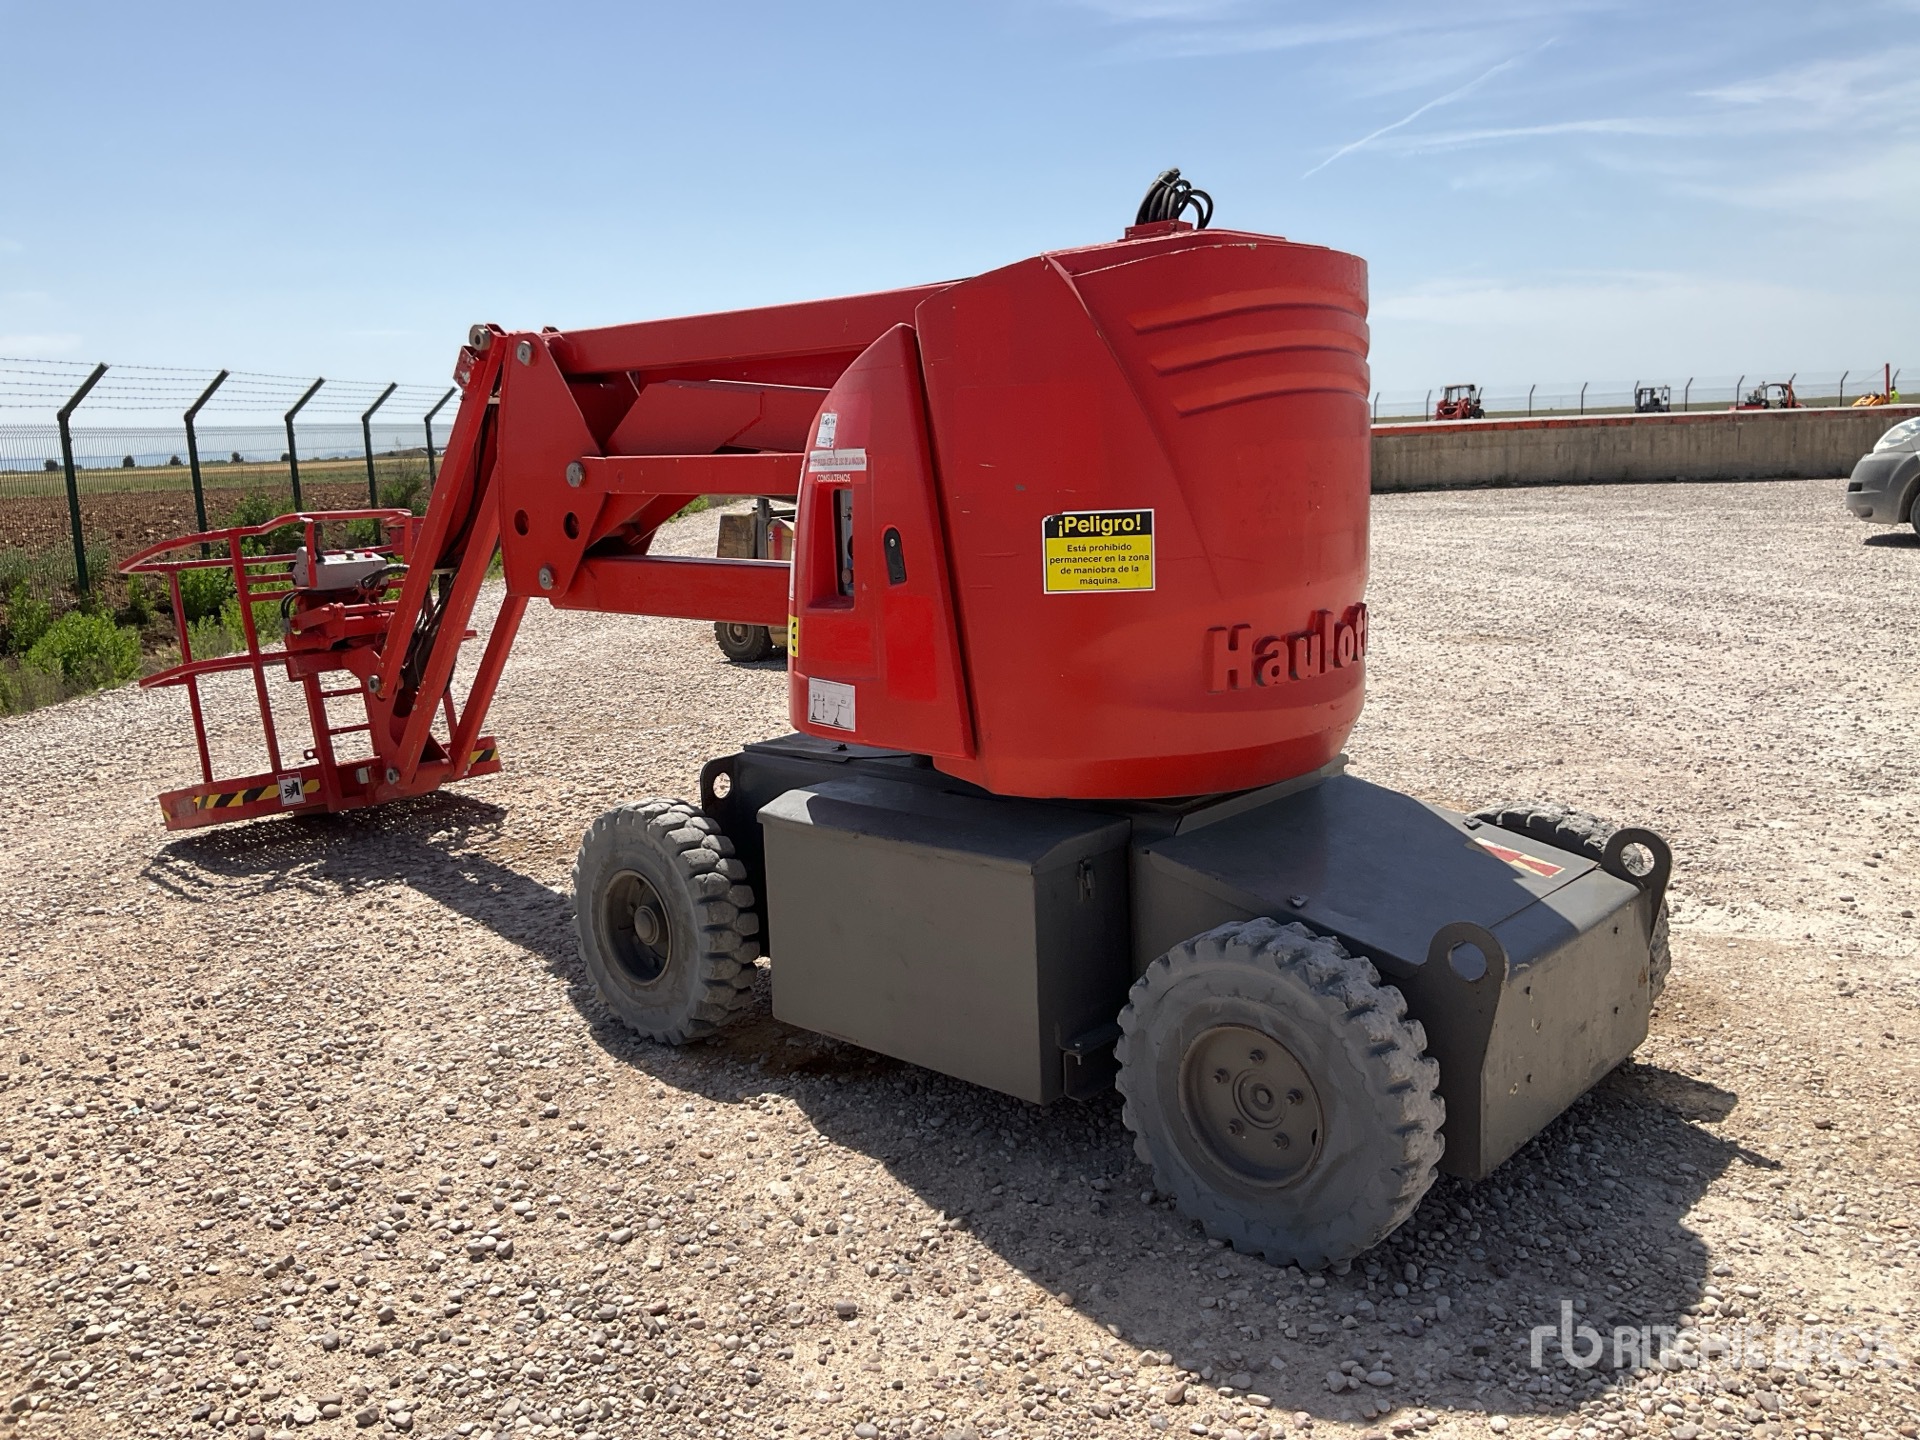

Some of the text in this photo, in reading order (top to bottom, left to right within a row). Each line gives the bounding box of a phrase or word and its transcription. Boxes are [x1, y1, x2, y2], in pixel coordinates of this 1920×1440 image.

[1058, 514, 1141, 537] ¡Peligro!
[1067, 543, 1132, 553] Está prohibido
[1050, 556, 1102, 565] permanecer
[1074, 566, 1115, 574] maniobra
[1118, 565, 1129, 573] de
[1080, 577, 1120, 586] máquina.
[1203, 602, 1369, 694] Haulot
